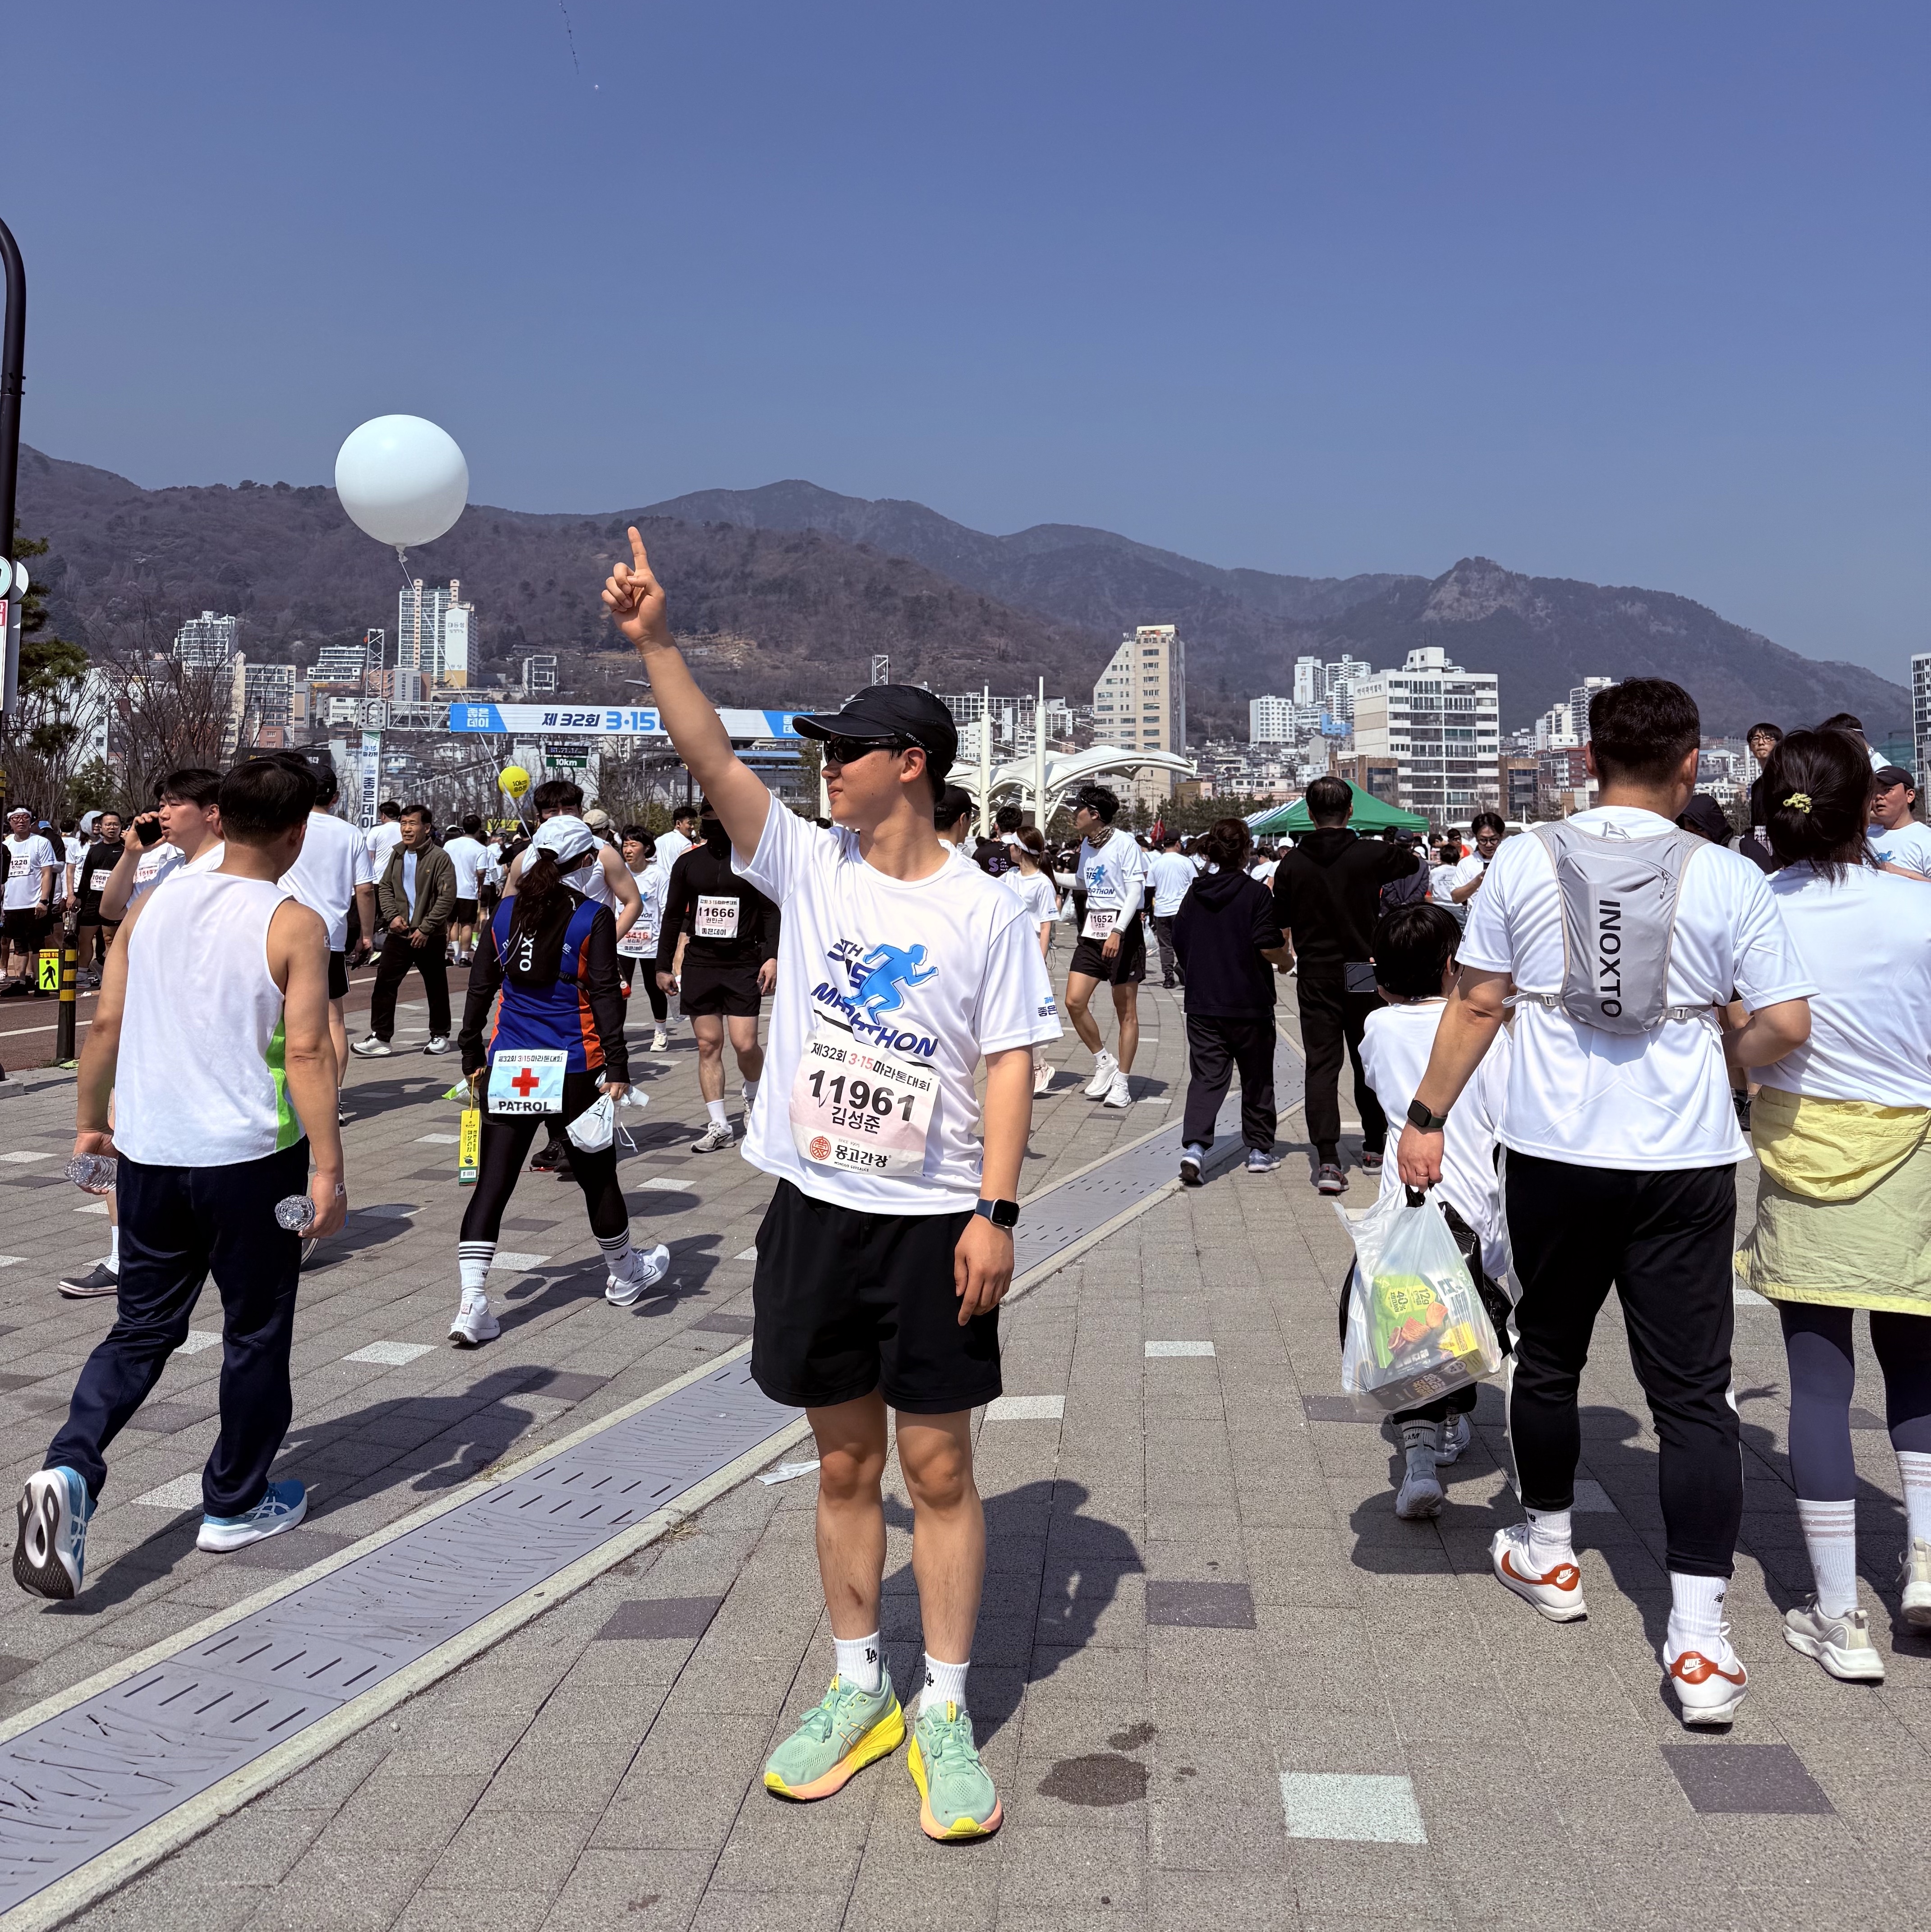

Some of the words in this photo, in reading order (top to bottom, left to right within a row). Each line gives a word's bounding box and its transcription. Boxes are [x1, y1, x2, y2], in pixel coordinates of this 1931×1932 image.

[467, 707, 489, 717] 좋은
[467, 718, 489, 728] 데이
[542, 713, 558, 726] 제
[560, 713, 601, 727] 32회
[699, 907, 734, 918] 11666
[1600, 899, 1622, 1018] INOXTO
[811, 1042, 847, 1063] 제32회
[809, 1070, 915, 1122] 11961
[499, 1101, 551, 1112] PATROL
[831, 1106, 881, 1134] 김성준
[835, 1144, 888, 1168] 몽고간장
[1559, 1568, 1573, 1579] NIKE
[865, 1647, 877, 1664] LA
[1684, 1658, 1701, 1668] NIKE
